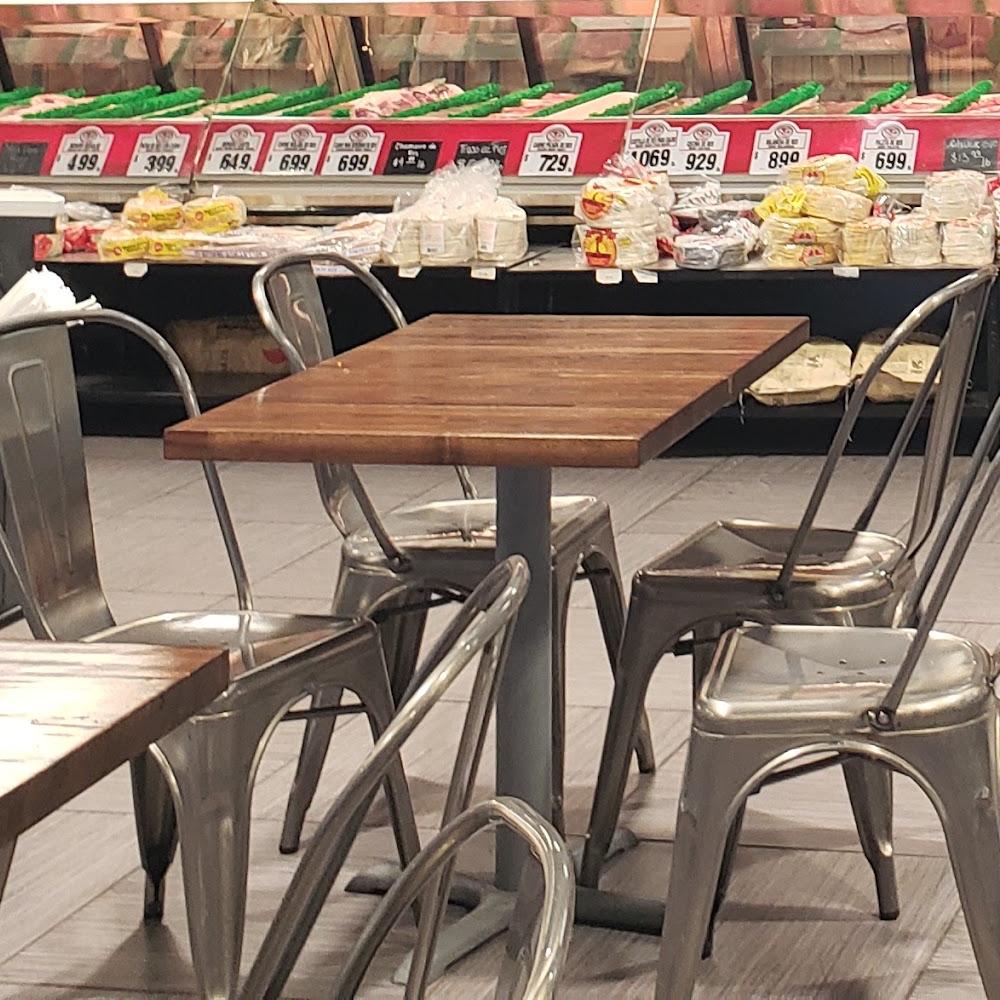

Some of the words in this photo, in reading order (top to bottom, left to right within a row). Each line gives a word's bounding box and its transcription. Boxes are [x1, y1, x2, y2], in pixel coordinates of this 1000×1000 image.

[144, 155, 176, 172] 399
[279, 154, 311, 171] 699
[338, 154, 370, 172] 699
[539, 154, 569, 172] 729
[685, 153, 717, 171] 929
[875, 152, 907, 170] 699
